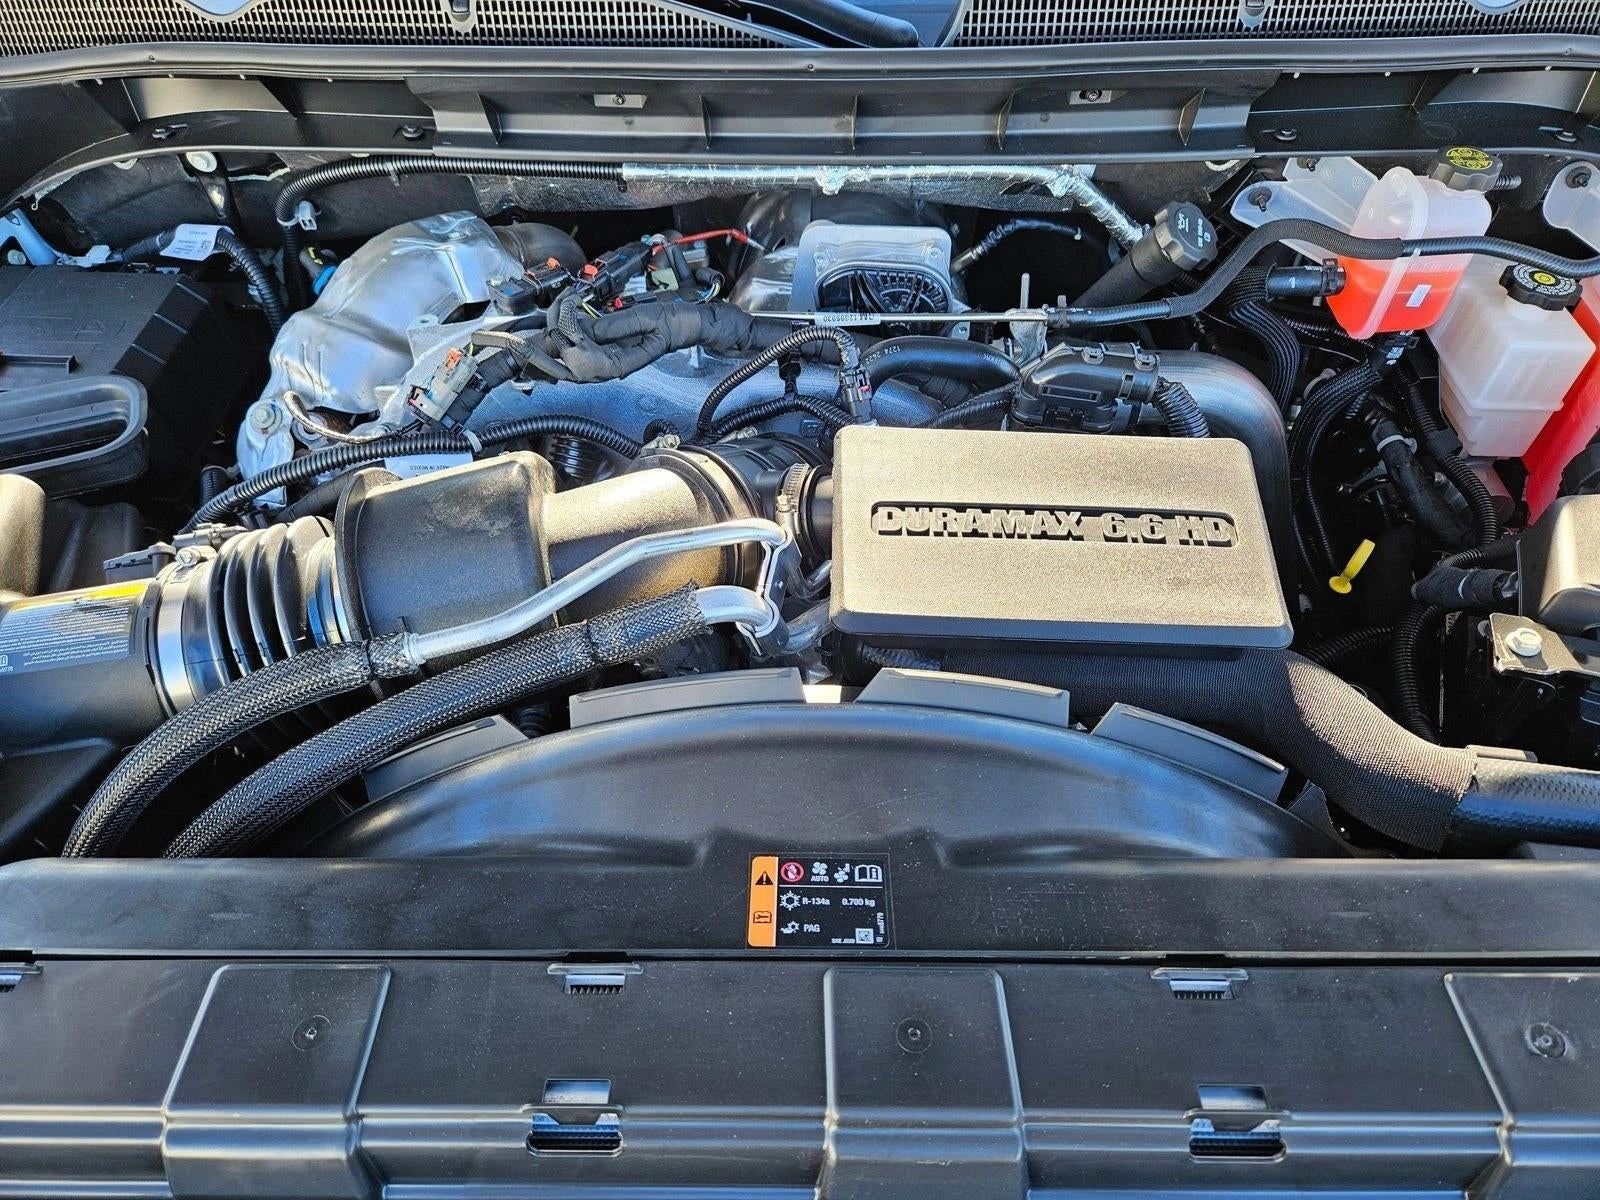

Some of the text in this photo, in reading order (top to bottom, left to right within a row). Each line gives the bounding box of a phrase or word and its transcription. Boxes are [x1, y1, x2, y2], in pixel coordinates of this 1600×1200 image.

[876, 506, 1233, 548] DURAMAX 6.6 HD
[802, 897, 876, 908] R-134a 0.700 kg
[803, 924, 820, 932] PAG
